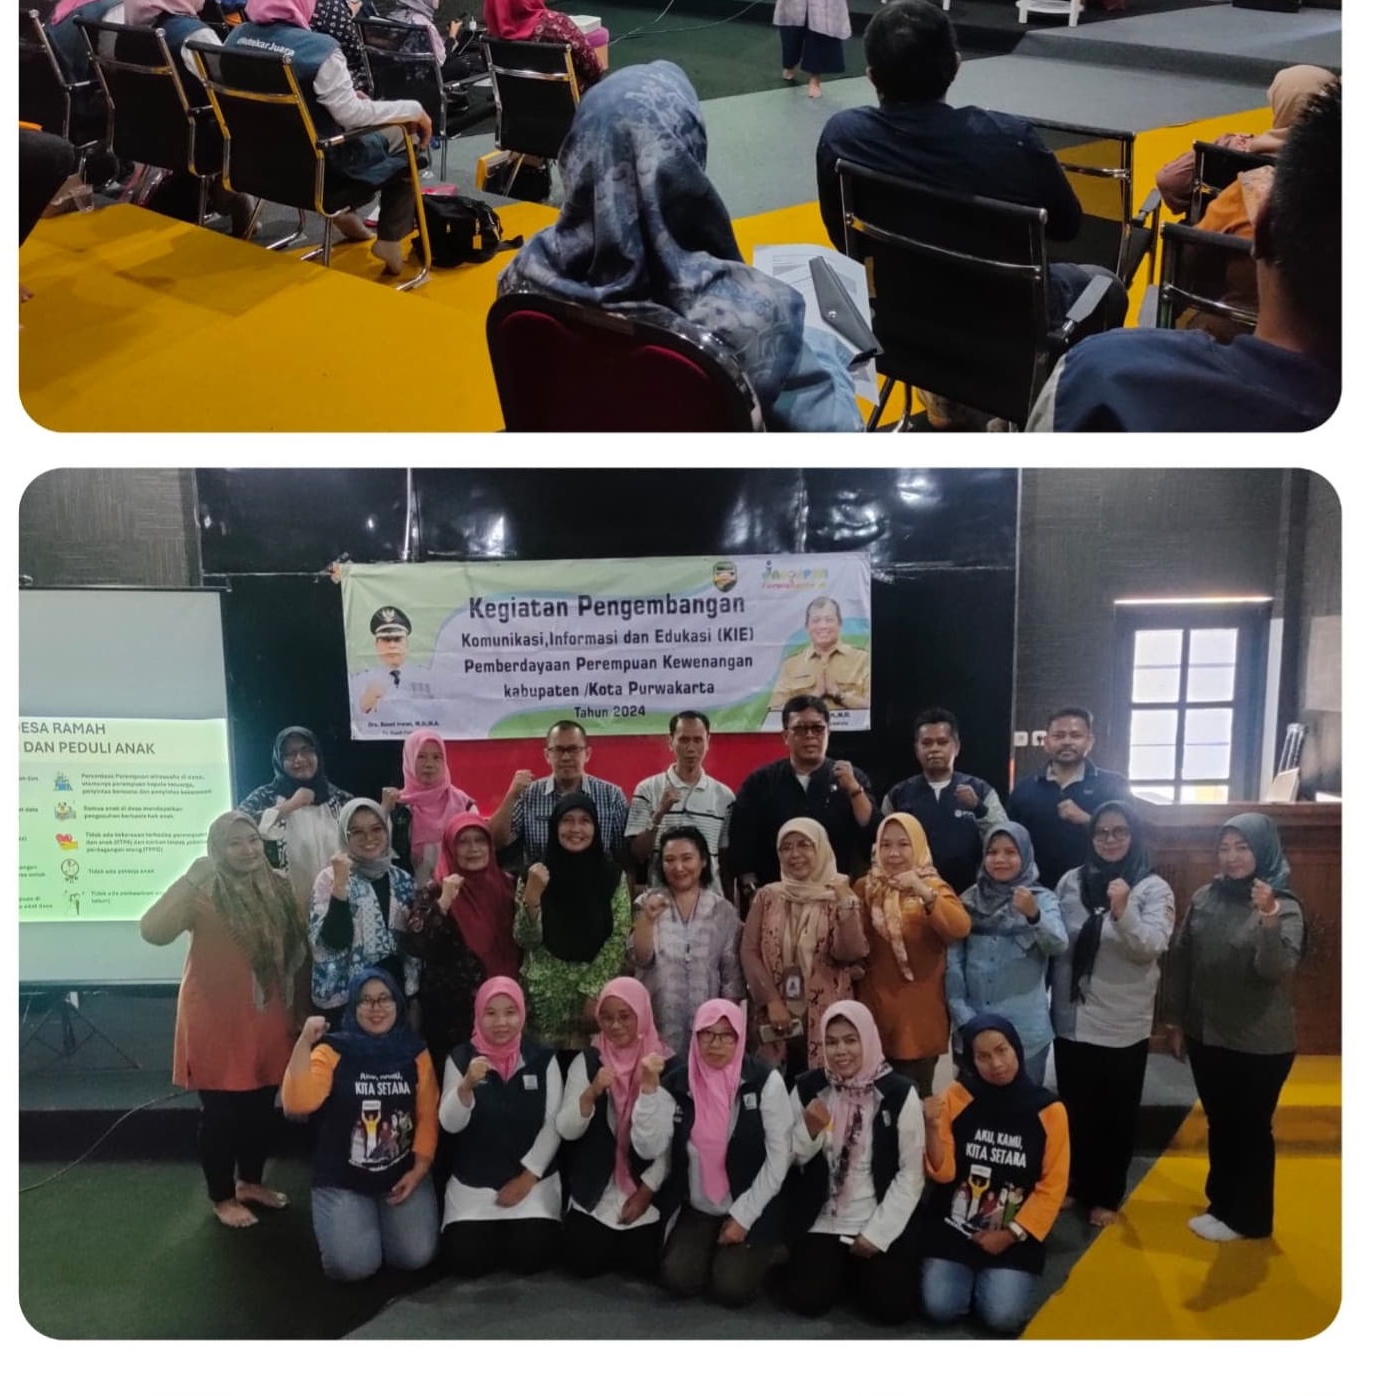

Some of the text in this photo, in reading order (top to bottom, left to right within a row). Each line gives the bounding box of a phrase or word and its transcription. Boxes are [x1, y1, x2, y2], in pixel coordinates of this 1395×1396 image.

[469, 594, 745, 623] Kegiatan Pengembangan
[461, 626, 754, 650] Komunikasi,Informasi dan Edukasi (KIE)
[464, 653, 753, 676] Pemberdayaan Perempuan Kewenangan
[503, 681, 715, 702] kabupaten /Kota Purwakarta
[574, 704, 646, 719] Tahun 2024
[19, 722, 106, 734] ESA RAMAH
[24, 741, 156, 755] DAN PEDULI ANAK
[355, 1081, 376, 1096] KITA
[974, 1128, 1023, 1150] AKU, KAMU,
[966, 1142, 1027, 1168] KITA SETARA
